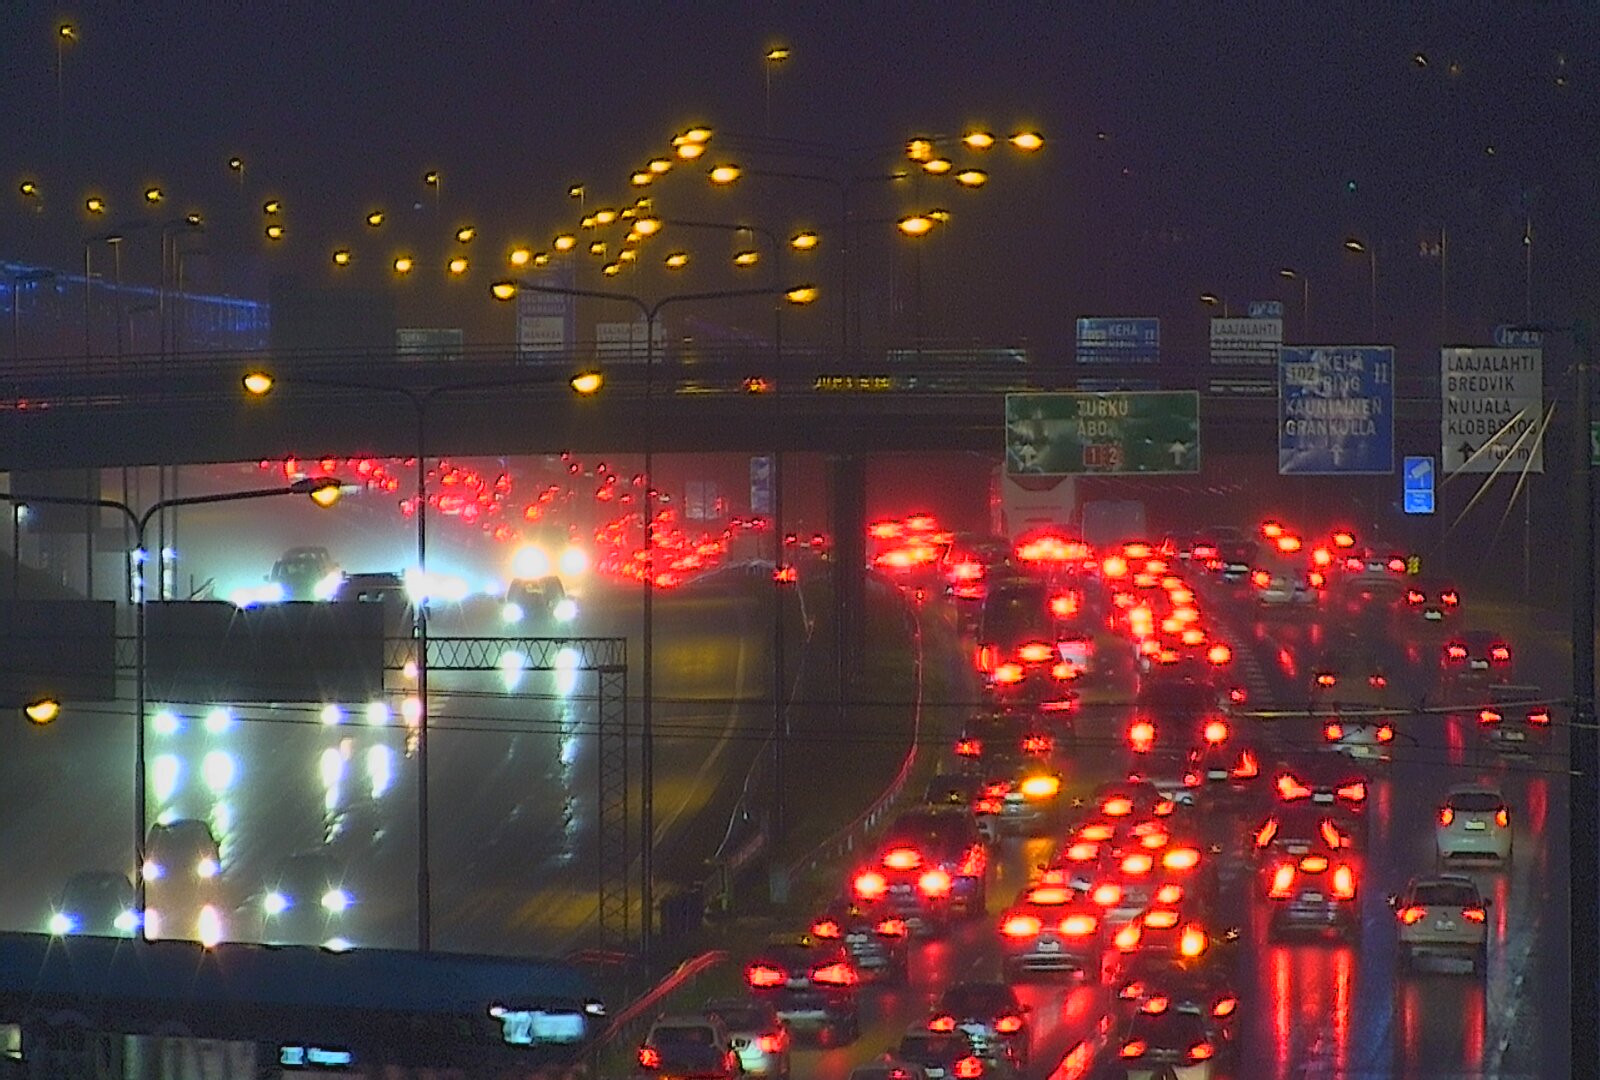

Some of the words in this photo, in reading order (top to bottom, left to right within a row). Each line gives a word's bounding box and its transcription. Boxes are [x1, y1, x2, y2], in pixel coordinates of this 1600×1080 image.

[1446, 355, 1535, 373] LAAJALAHTI
[1291, 367, 1315, 381] 102
[1323, 375, 1361, 392] RING
[1447, 376, 1515, 392] BREDVIK
[1076, 400, 1129, 417] TURKU
[1447, 399, 1512, 414] NUIJALA
[1285, 418, 1377, 436] GRANKULLA
[1108, 447, 1118, 464] 2
